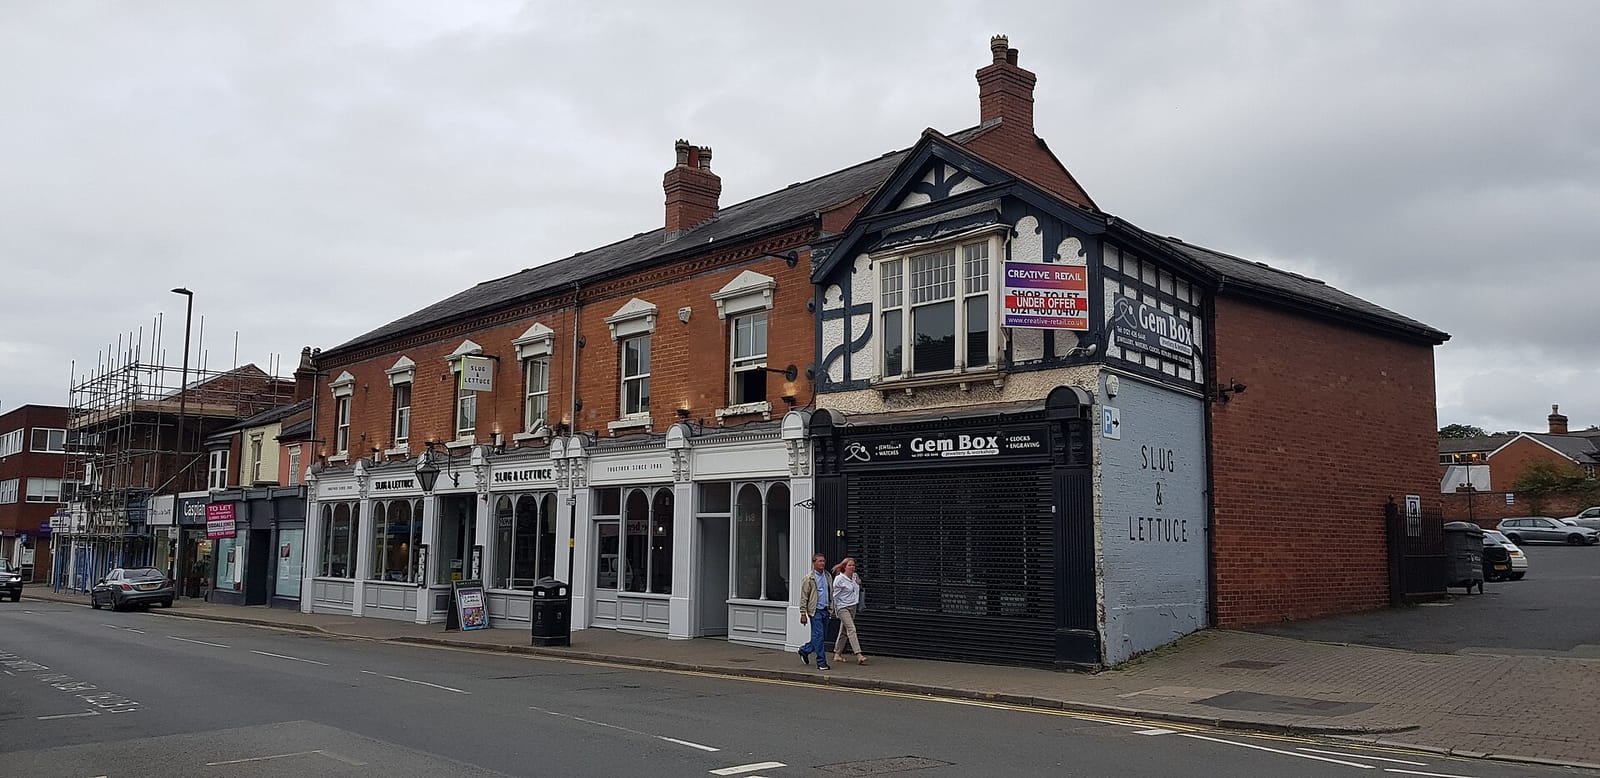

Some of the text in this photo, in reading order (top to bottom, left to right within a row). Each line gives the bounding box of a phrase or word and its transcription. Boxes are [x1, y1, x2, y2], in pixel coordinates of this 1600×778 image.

[1008, 269, 1082, 281] CREATIVE RETAIL
[1016, 297, 1076, 309] UNDER OFFER
[1008, 317, 1084, 327] www.creative-retail.co.uk
[1139, 304, 1192, 346] Gem Box
[464, 377, 490, 385] LETTUCE
[910, 435, 998, 452] Gem Box
[1141, 444, 1174, 473] SLUG
[494, 471, 513, 482] SLUG
[519, 468, 552, 481] LETTUCE
[375, 480, 387, 490] SLUG
[392, 479, 415, 489] LETTUCE
[1155, 481, 1162, 506] &
[184, 501, 206, 523] Caspian
[1129, 516, 1188, 543] LETTUCE
